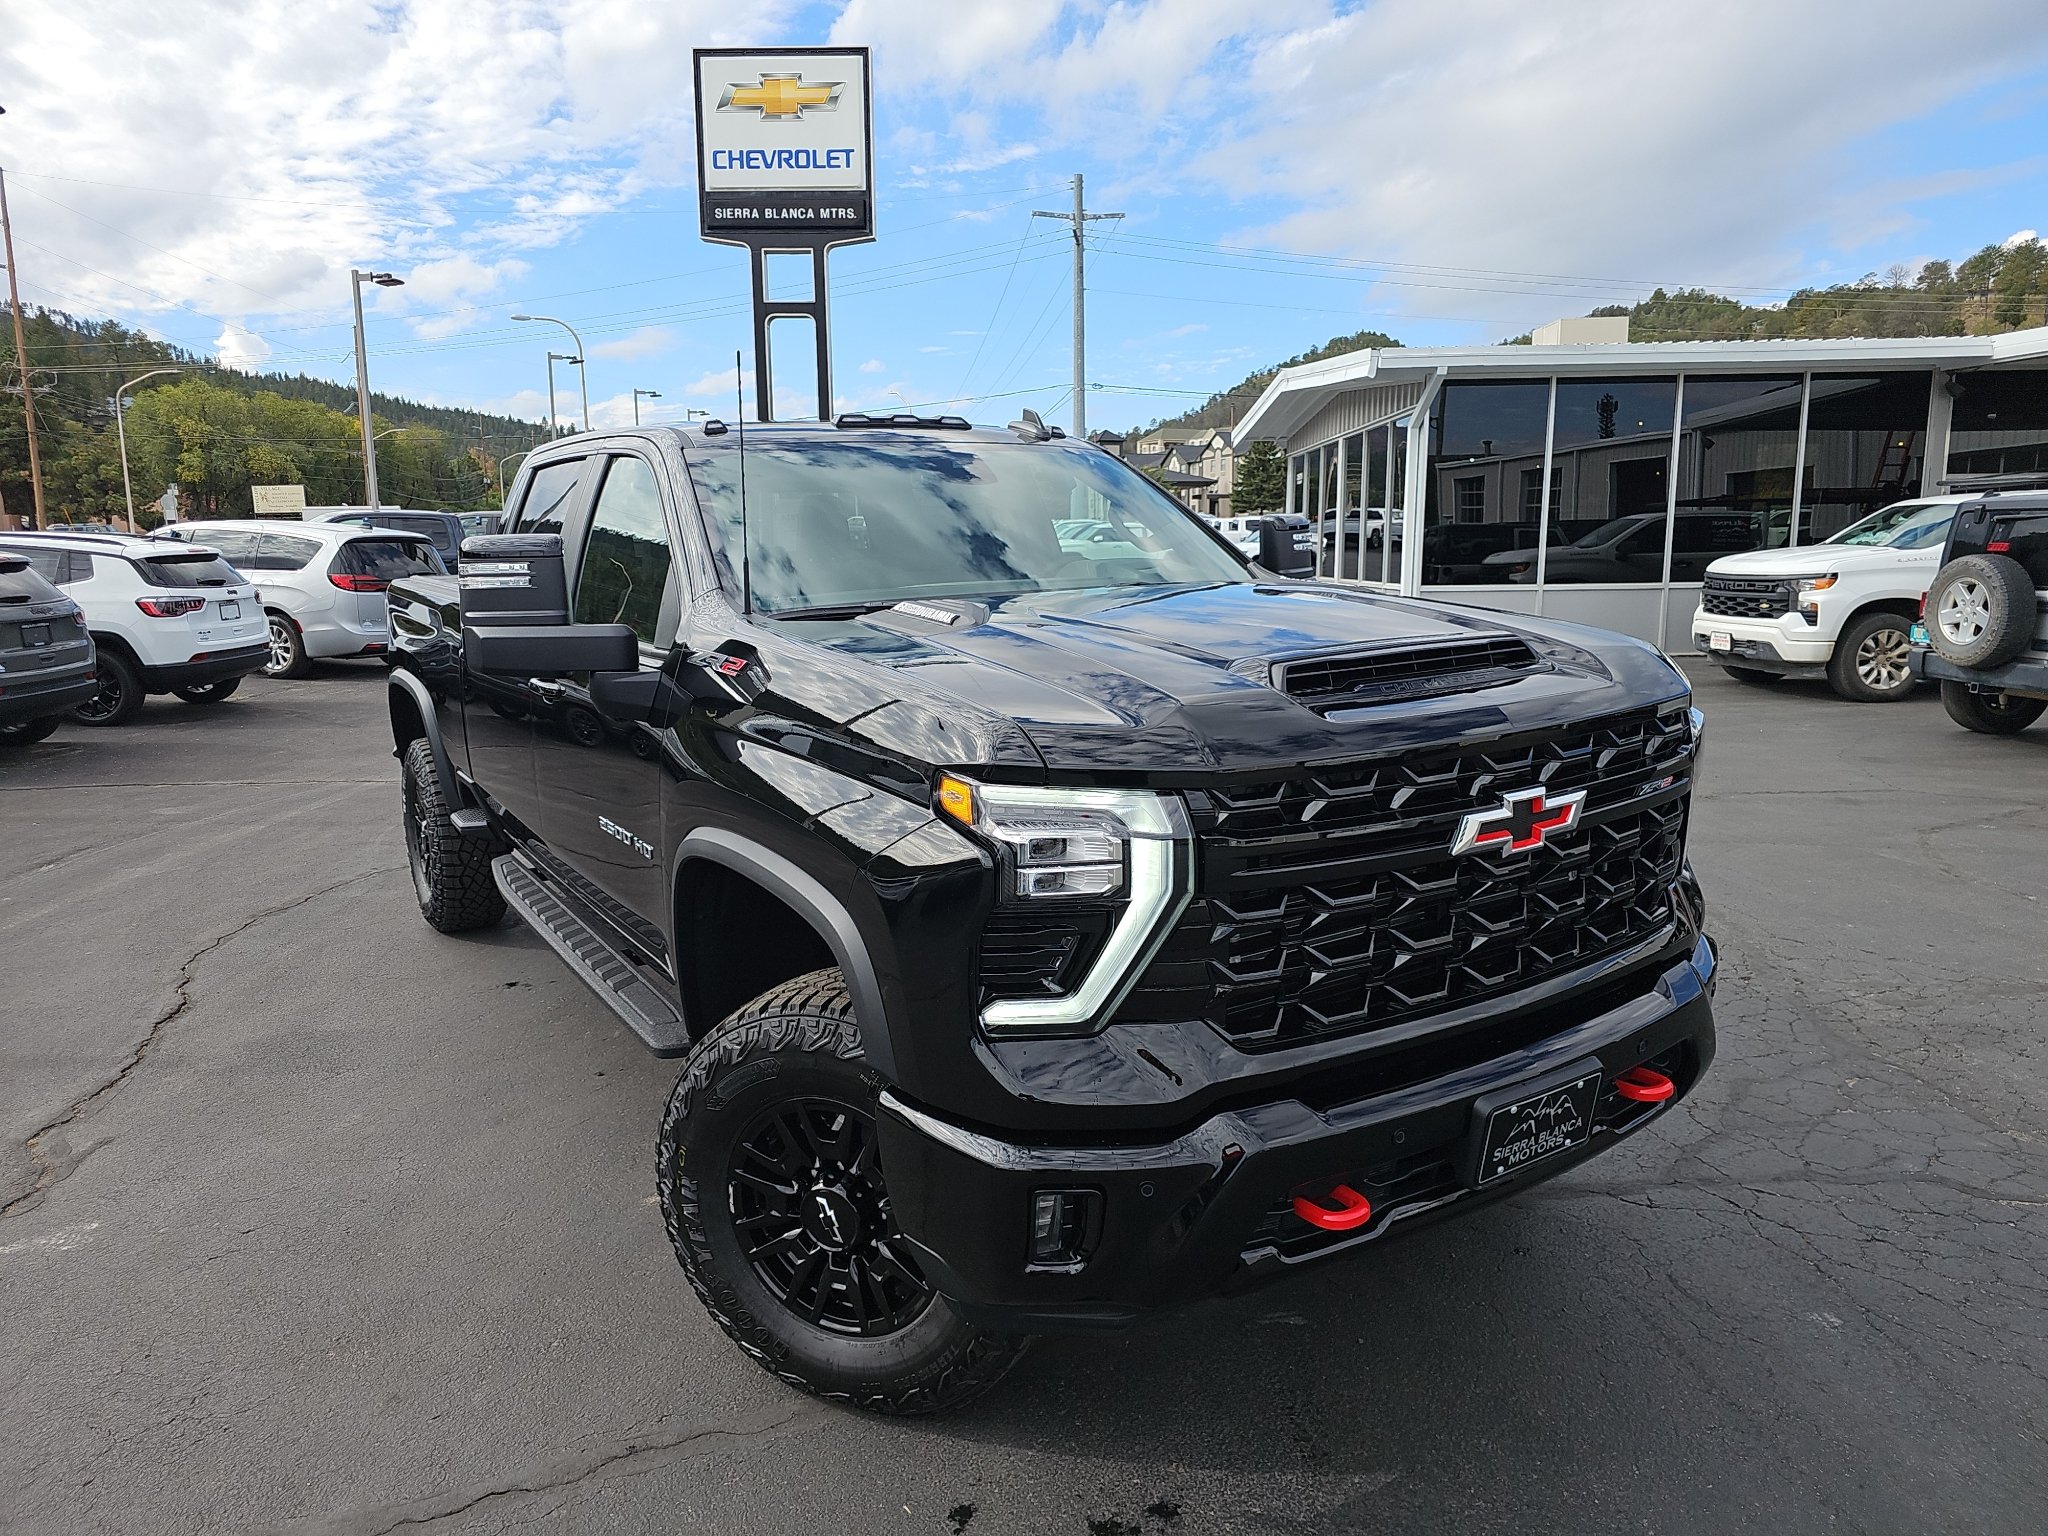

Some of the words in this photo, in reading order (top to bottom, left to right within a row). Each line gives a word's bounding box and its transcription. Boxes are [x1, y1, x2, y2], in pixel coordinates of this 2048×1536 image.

[712, 149, 855, 170] CHEVROLET
[714, 207, 760, 219] SIERRA
[764, 207, 815, 219] BLANCA
[819, 207, 857, 219] MTRS.
[687, 648, 749, 678] ZR2
[598, 815, 633, 846] 2500
[633, 836, 655, 861] HD
[1493, 1136, 1536, 1162] SIERRA
[1538, 1117, 1583, 1143] BLANCA
[1508, 1134, 1565, 1165] MOTORS
